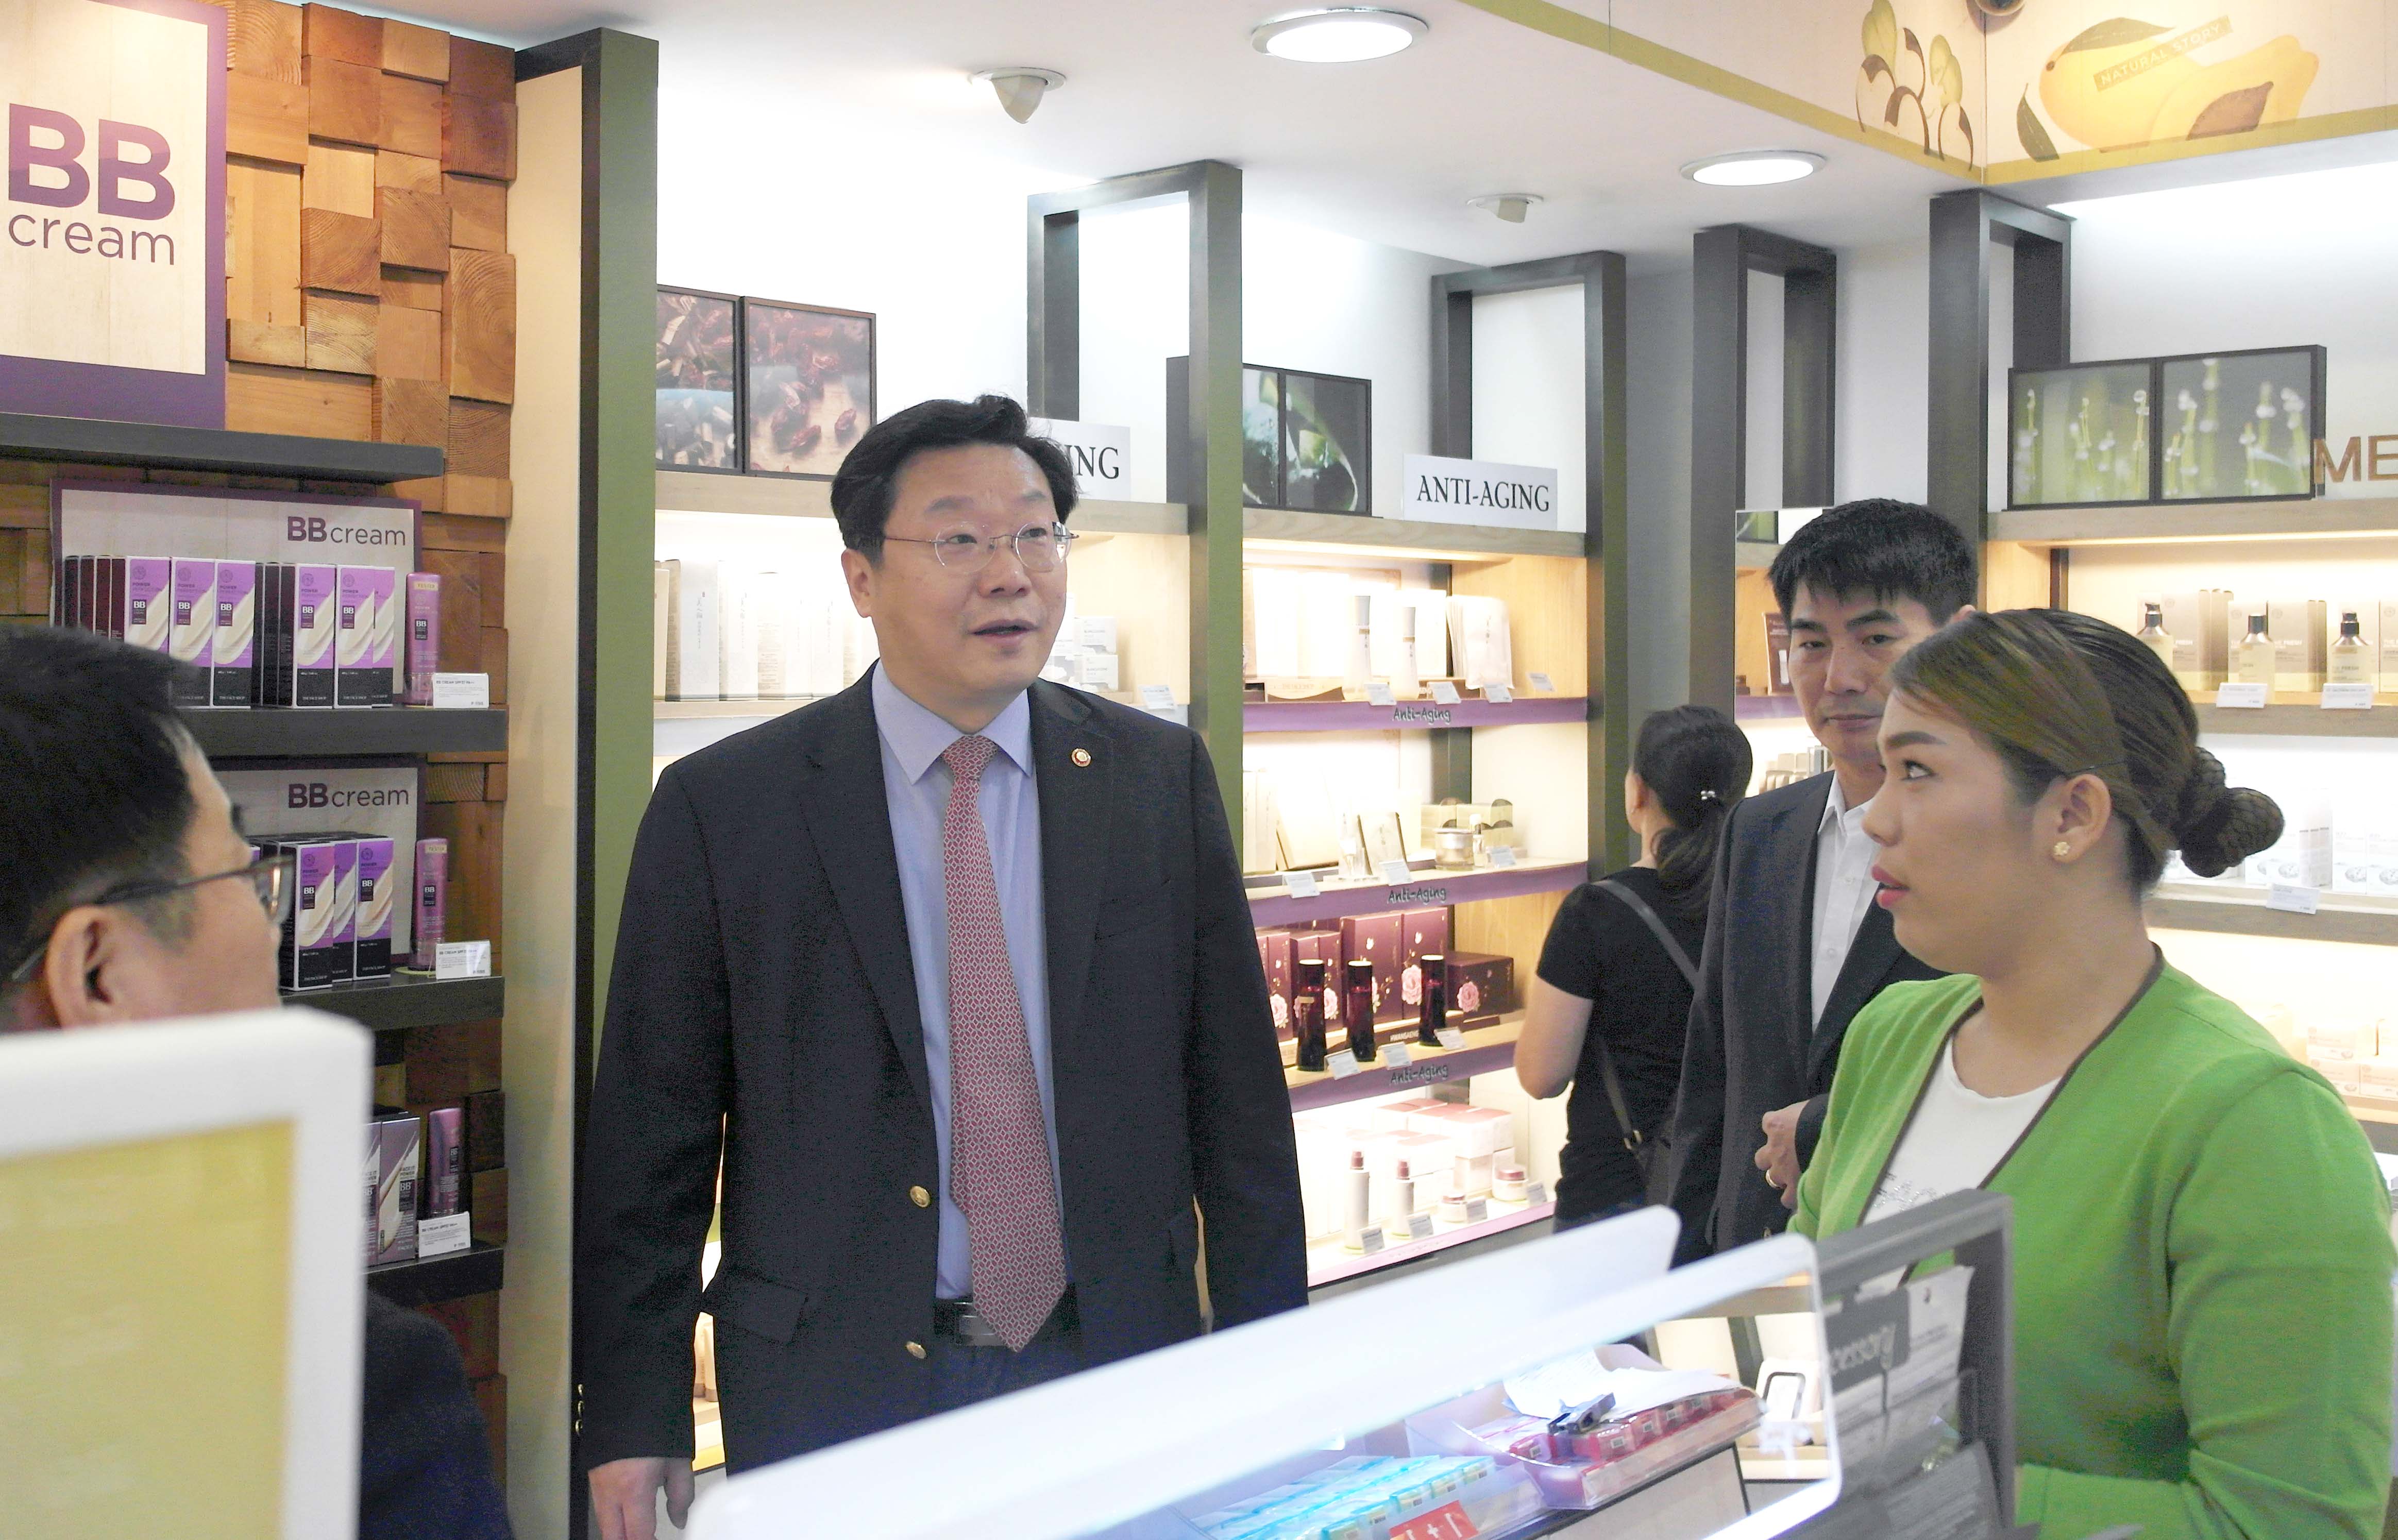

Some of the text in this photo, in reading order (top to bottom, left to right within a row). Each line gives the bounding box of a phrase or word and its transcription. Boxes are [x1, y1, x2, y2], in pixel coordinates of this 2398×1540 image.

[2101, 23, 2220, 85] NATURAL STORY
[8, 103, 175, 221] BB
[8, 214, 175, 265] cream
[1416, 475, 1549, 512] ANTI-AGING
[288, 516, 406, 546] BB cream
[1392, 707, 1451, 724] Anti-Aging
[288, 783, 409, 808] BB cream
[1387, 886, 1446, 905] Anti-Aging
[1390, 1063, 1448, 1084] Anti-Aging
[400, 1182, 411, 1191] BB
